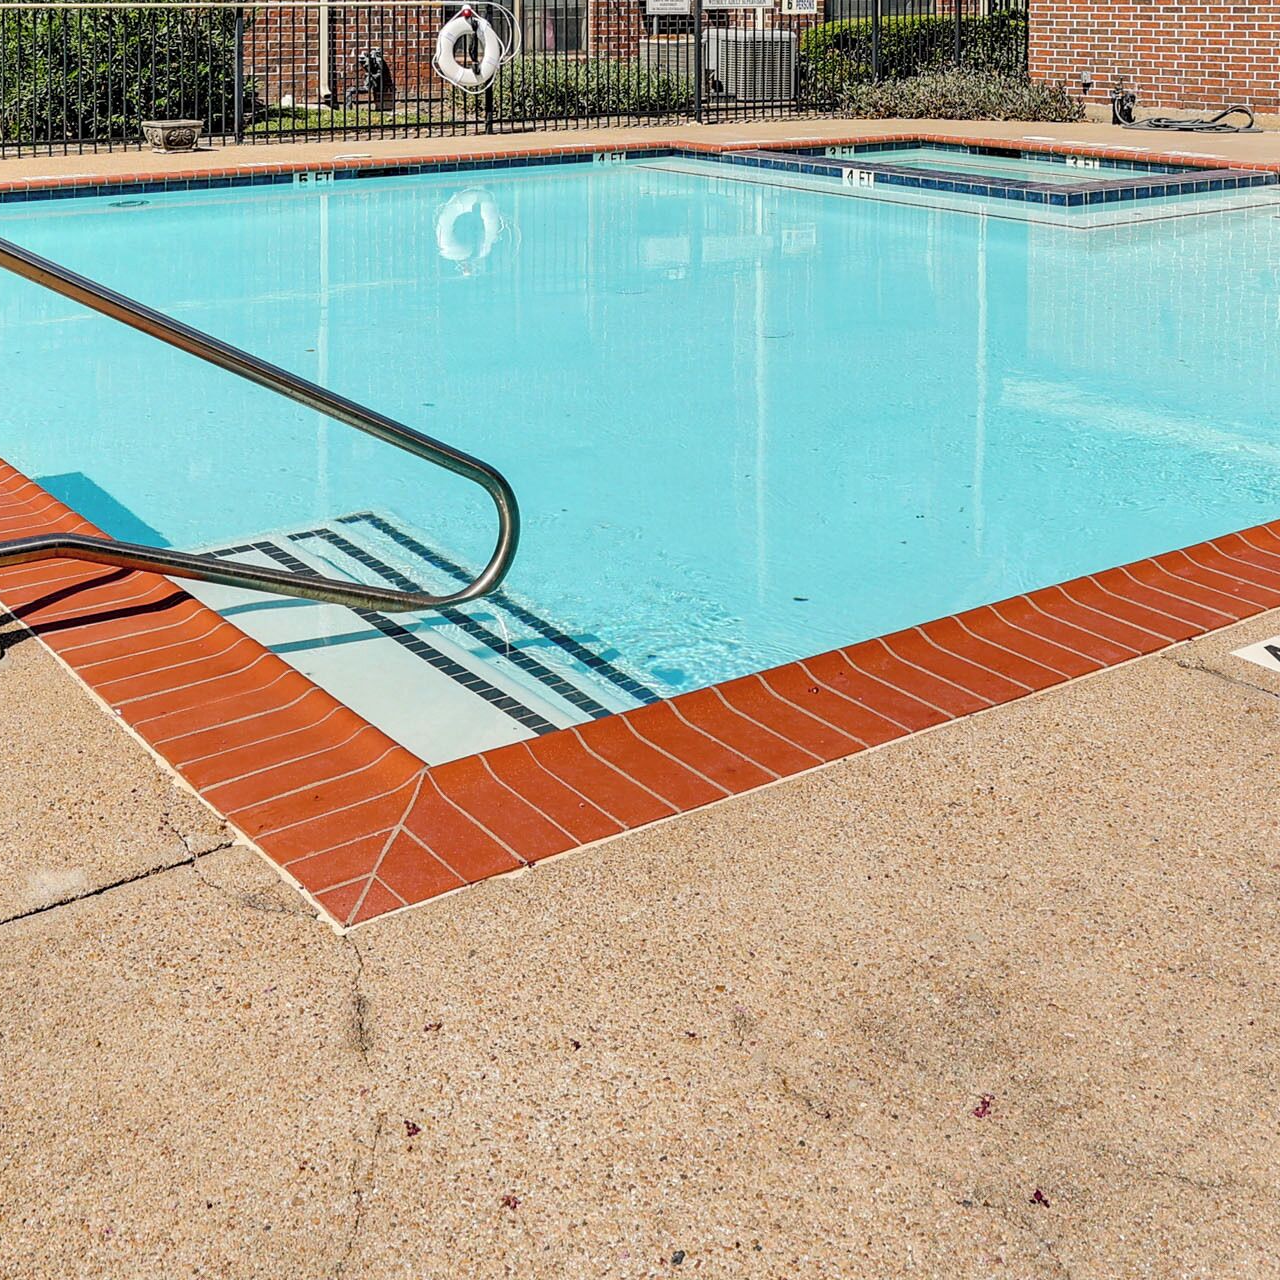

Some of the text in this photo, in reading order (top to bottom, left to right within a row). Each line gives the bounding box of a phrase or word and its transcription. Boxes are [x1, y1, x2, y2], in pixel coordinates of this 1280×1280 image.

[796, 0, 814, 10] PERSONS
[611, 152, 624, 161] FT
[315, 172, 332, 181] FT
[859, 171, 872, 183] FT
